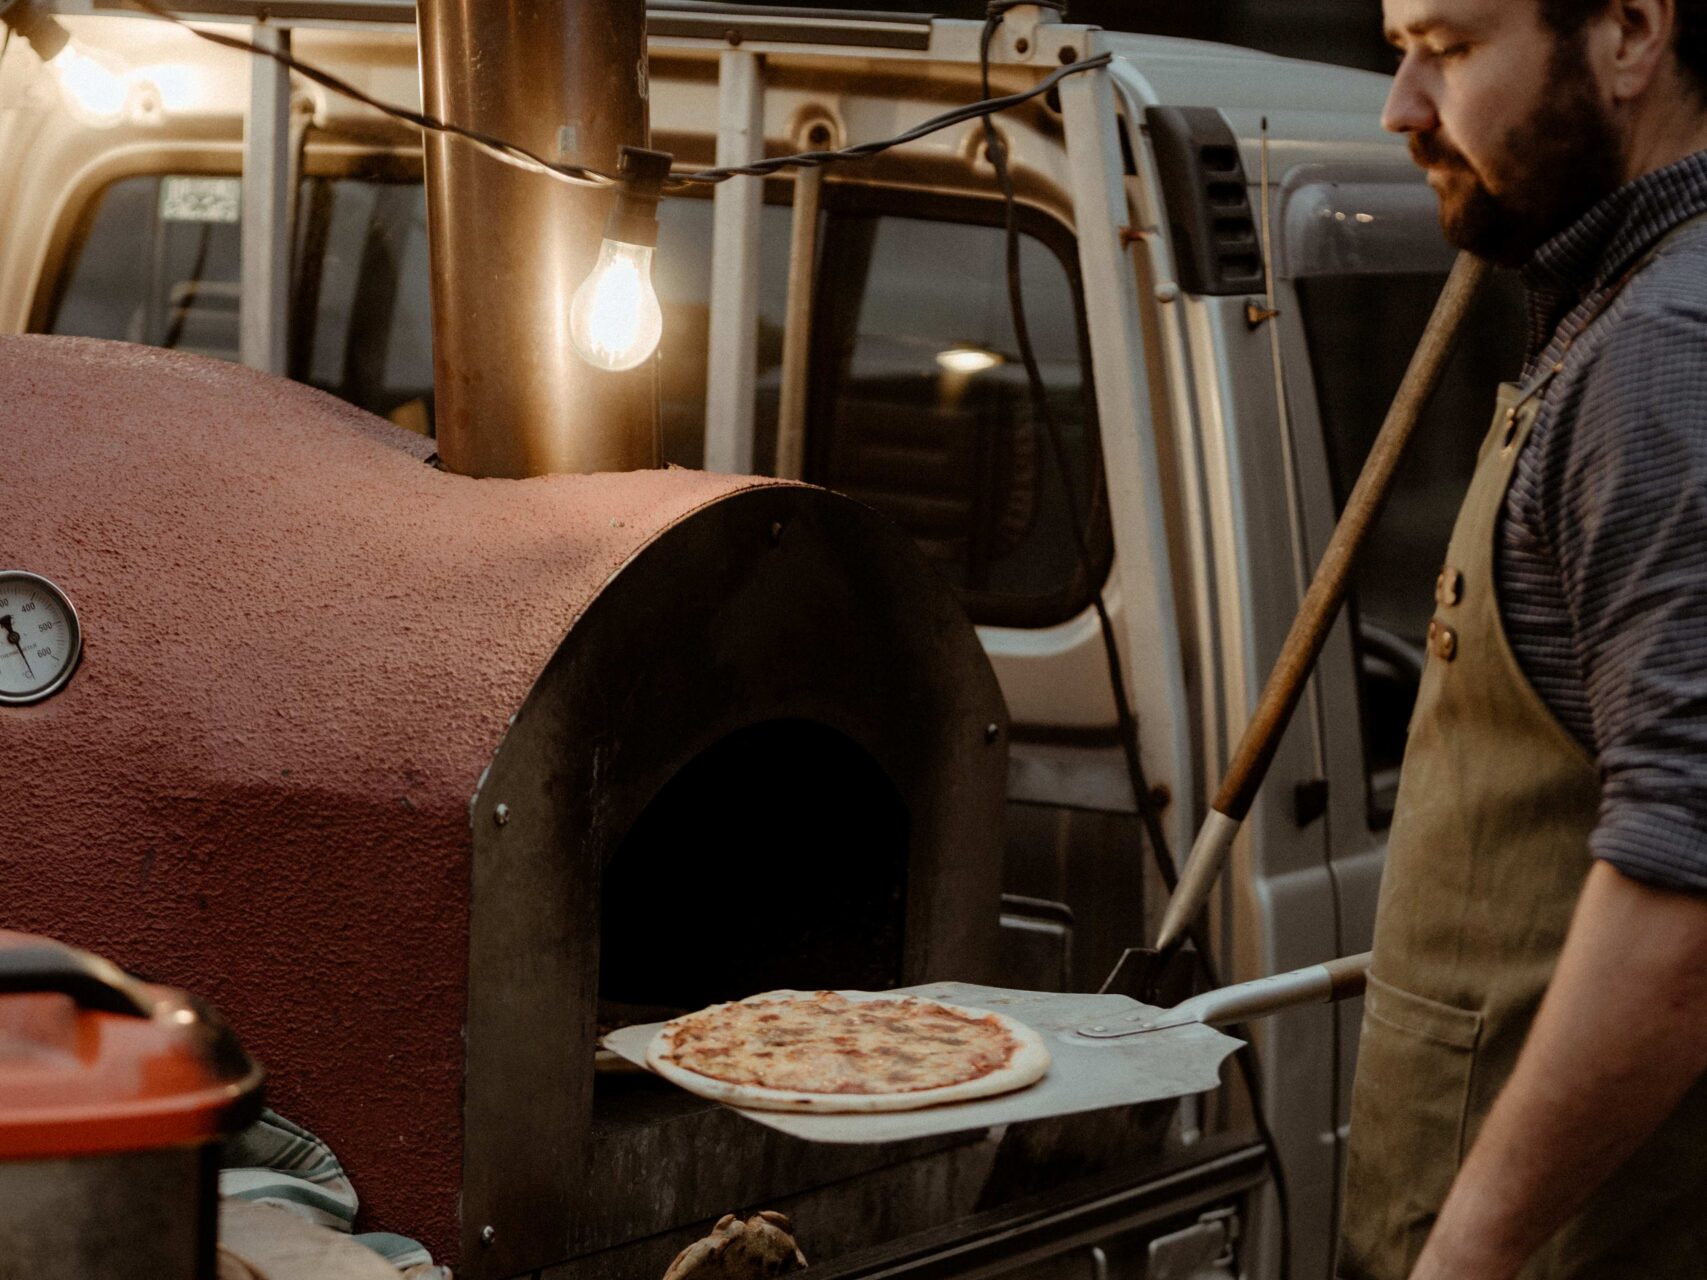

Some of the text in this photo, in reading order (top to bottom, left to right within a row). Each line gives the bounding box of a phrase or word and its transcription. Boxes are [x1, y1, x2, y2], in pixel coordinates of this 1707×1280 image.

[22, 602, 36, 613] 400
[38, 621, 53, 632] 500
[37, 647, 52, 658] 600
